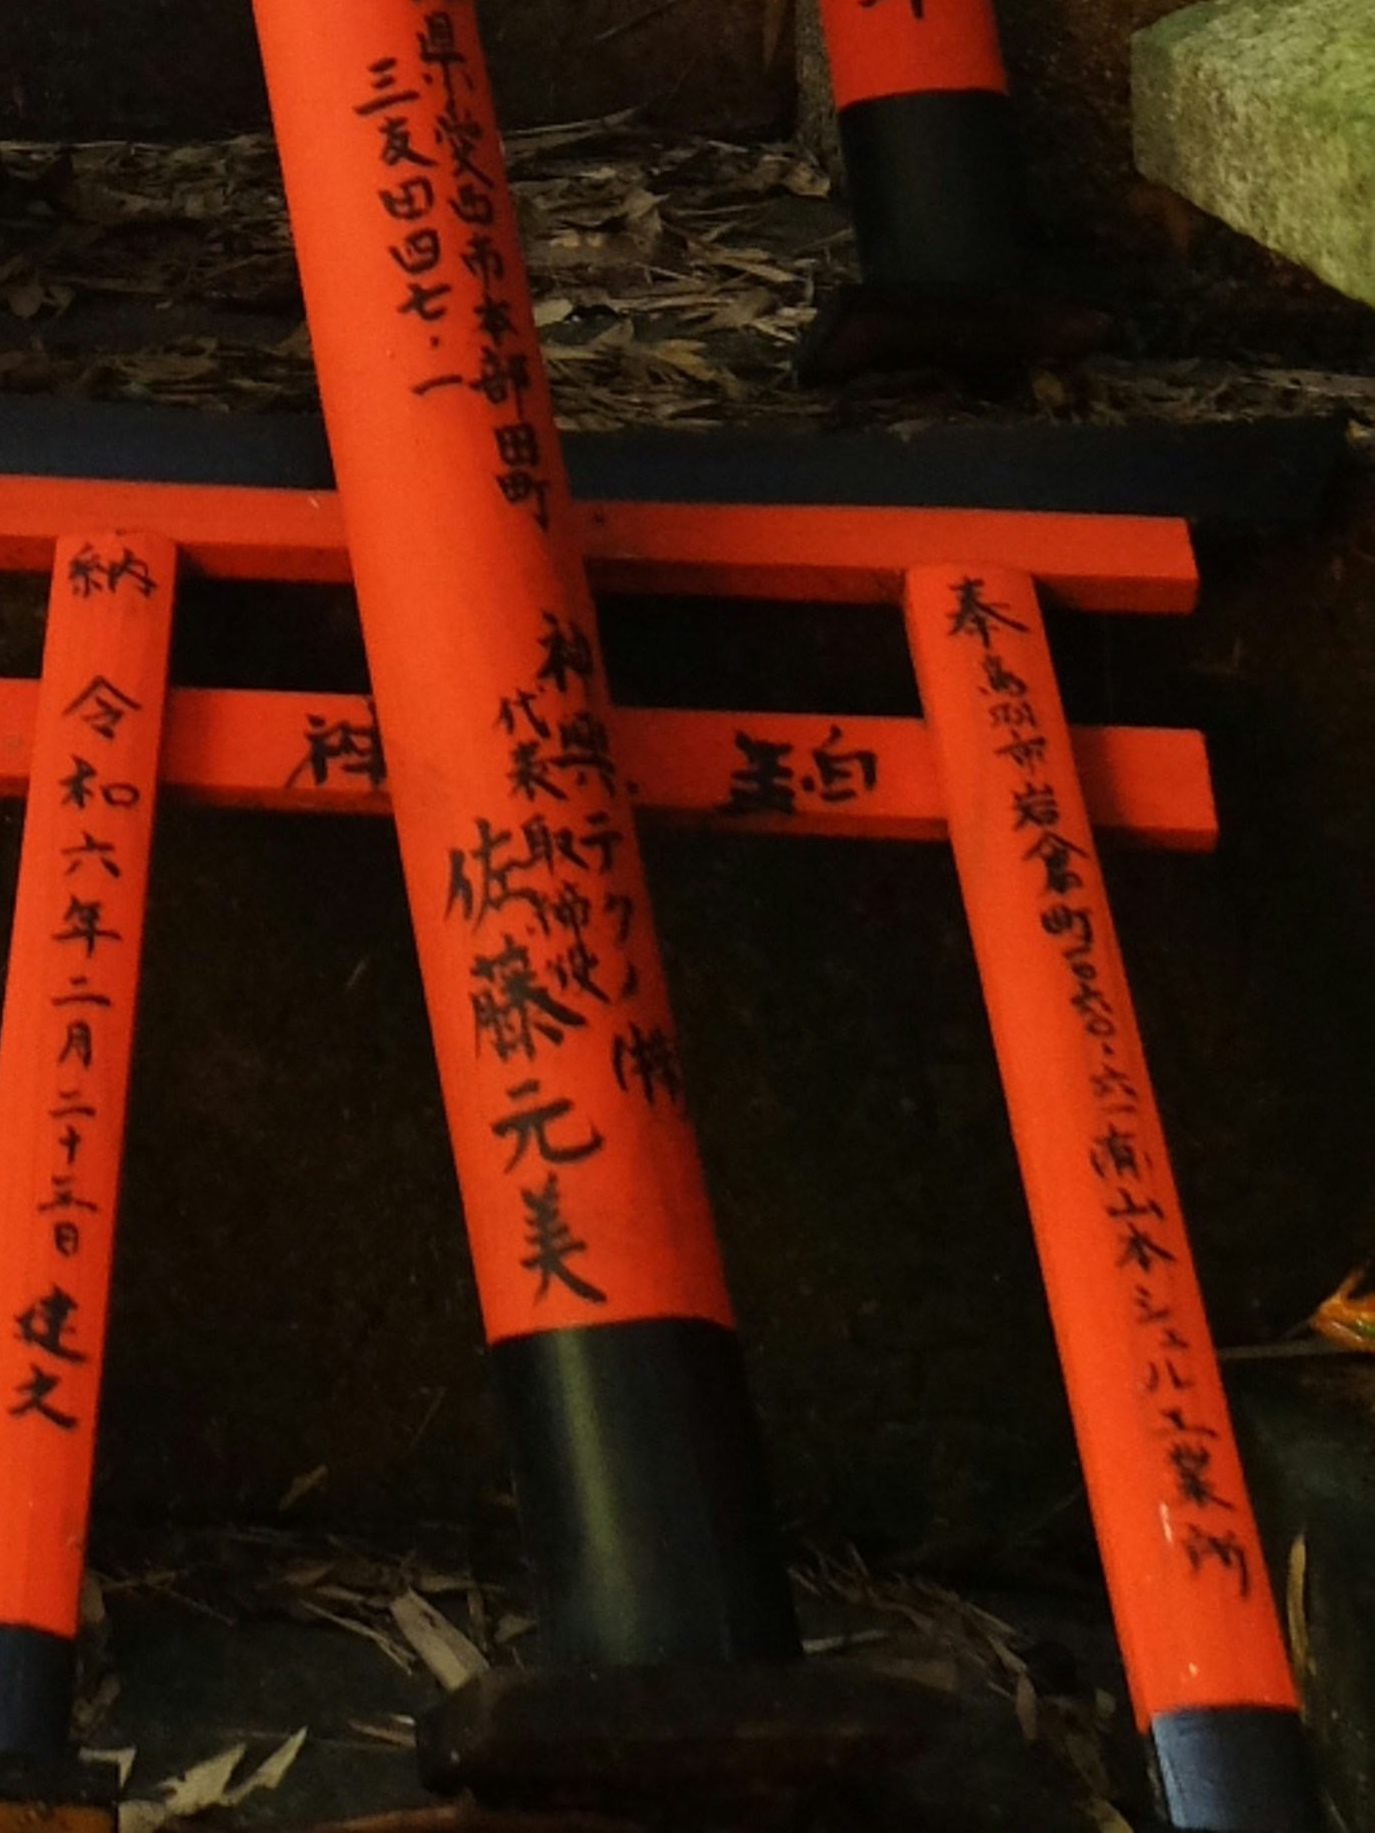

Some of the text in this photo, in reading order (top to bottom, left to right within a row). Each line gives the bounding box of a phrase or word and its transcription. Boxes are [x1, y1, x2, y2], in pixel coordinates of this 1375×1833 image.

[68, 529, 158, 601] 納
[945, 574, 1029, 649] 奉
[443, 816, 607, 1307] 佐藤元美
